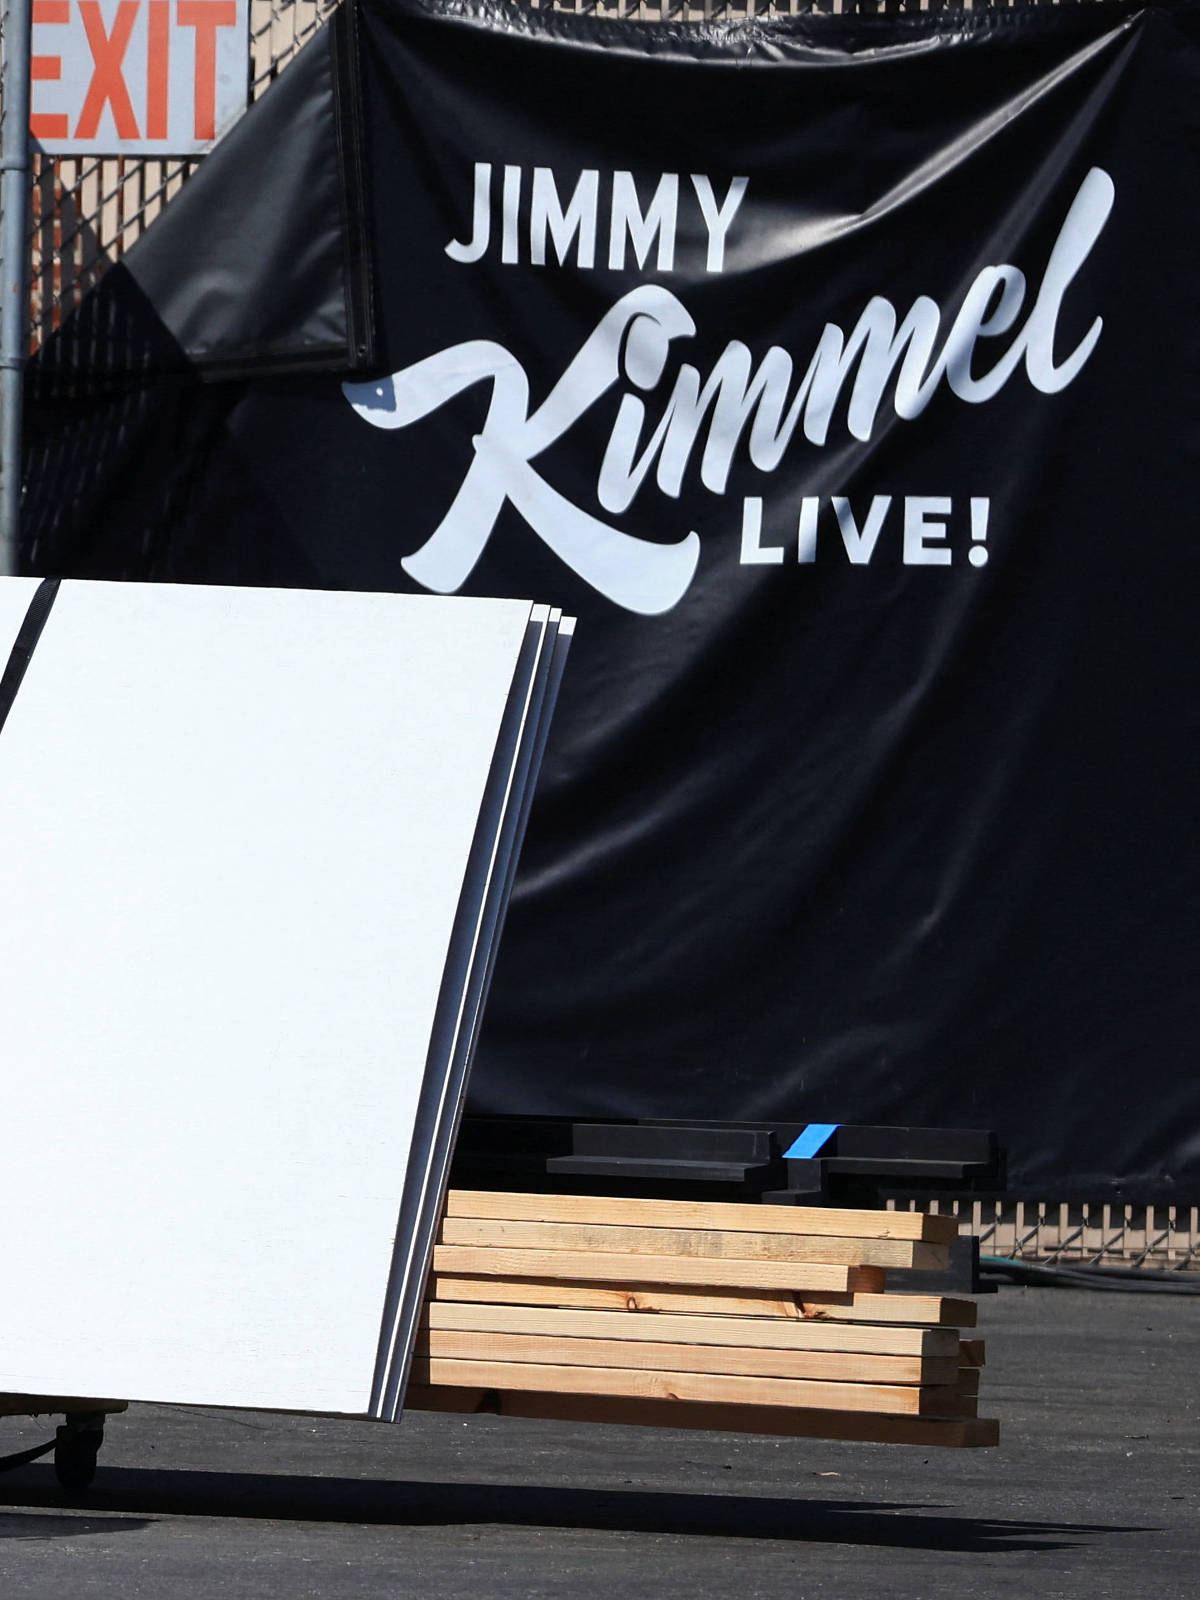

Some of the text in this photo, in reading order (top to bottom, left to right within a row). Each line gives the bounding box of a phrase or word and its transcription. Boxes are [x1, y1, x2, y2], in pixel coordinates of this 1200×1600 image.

[29, 0, 237, 140] EXIT
[444, 162, 750, 273] JIMMY
[341, 166, 1115, 616] Kimmel
[739, 494, 991, 568] LIVE!
